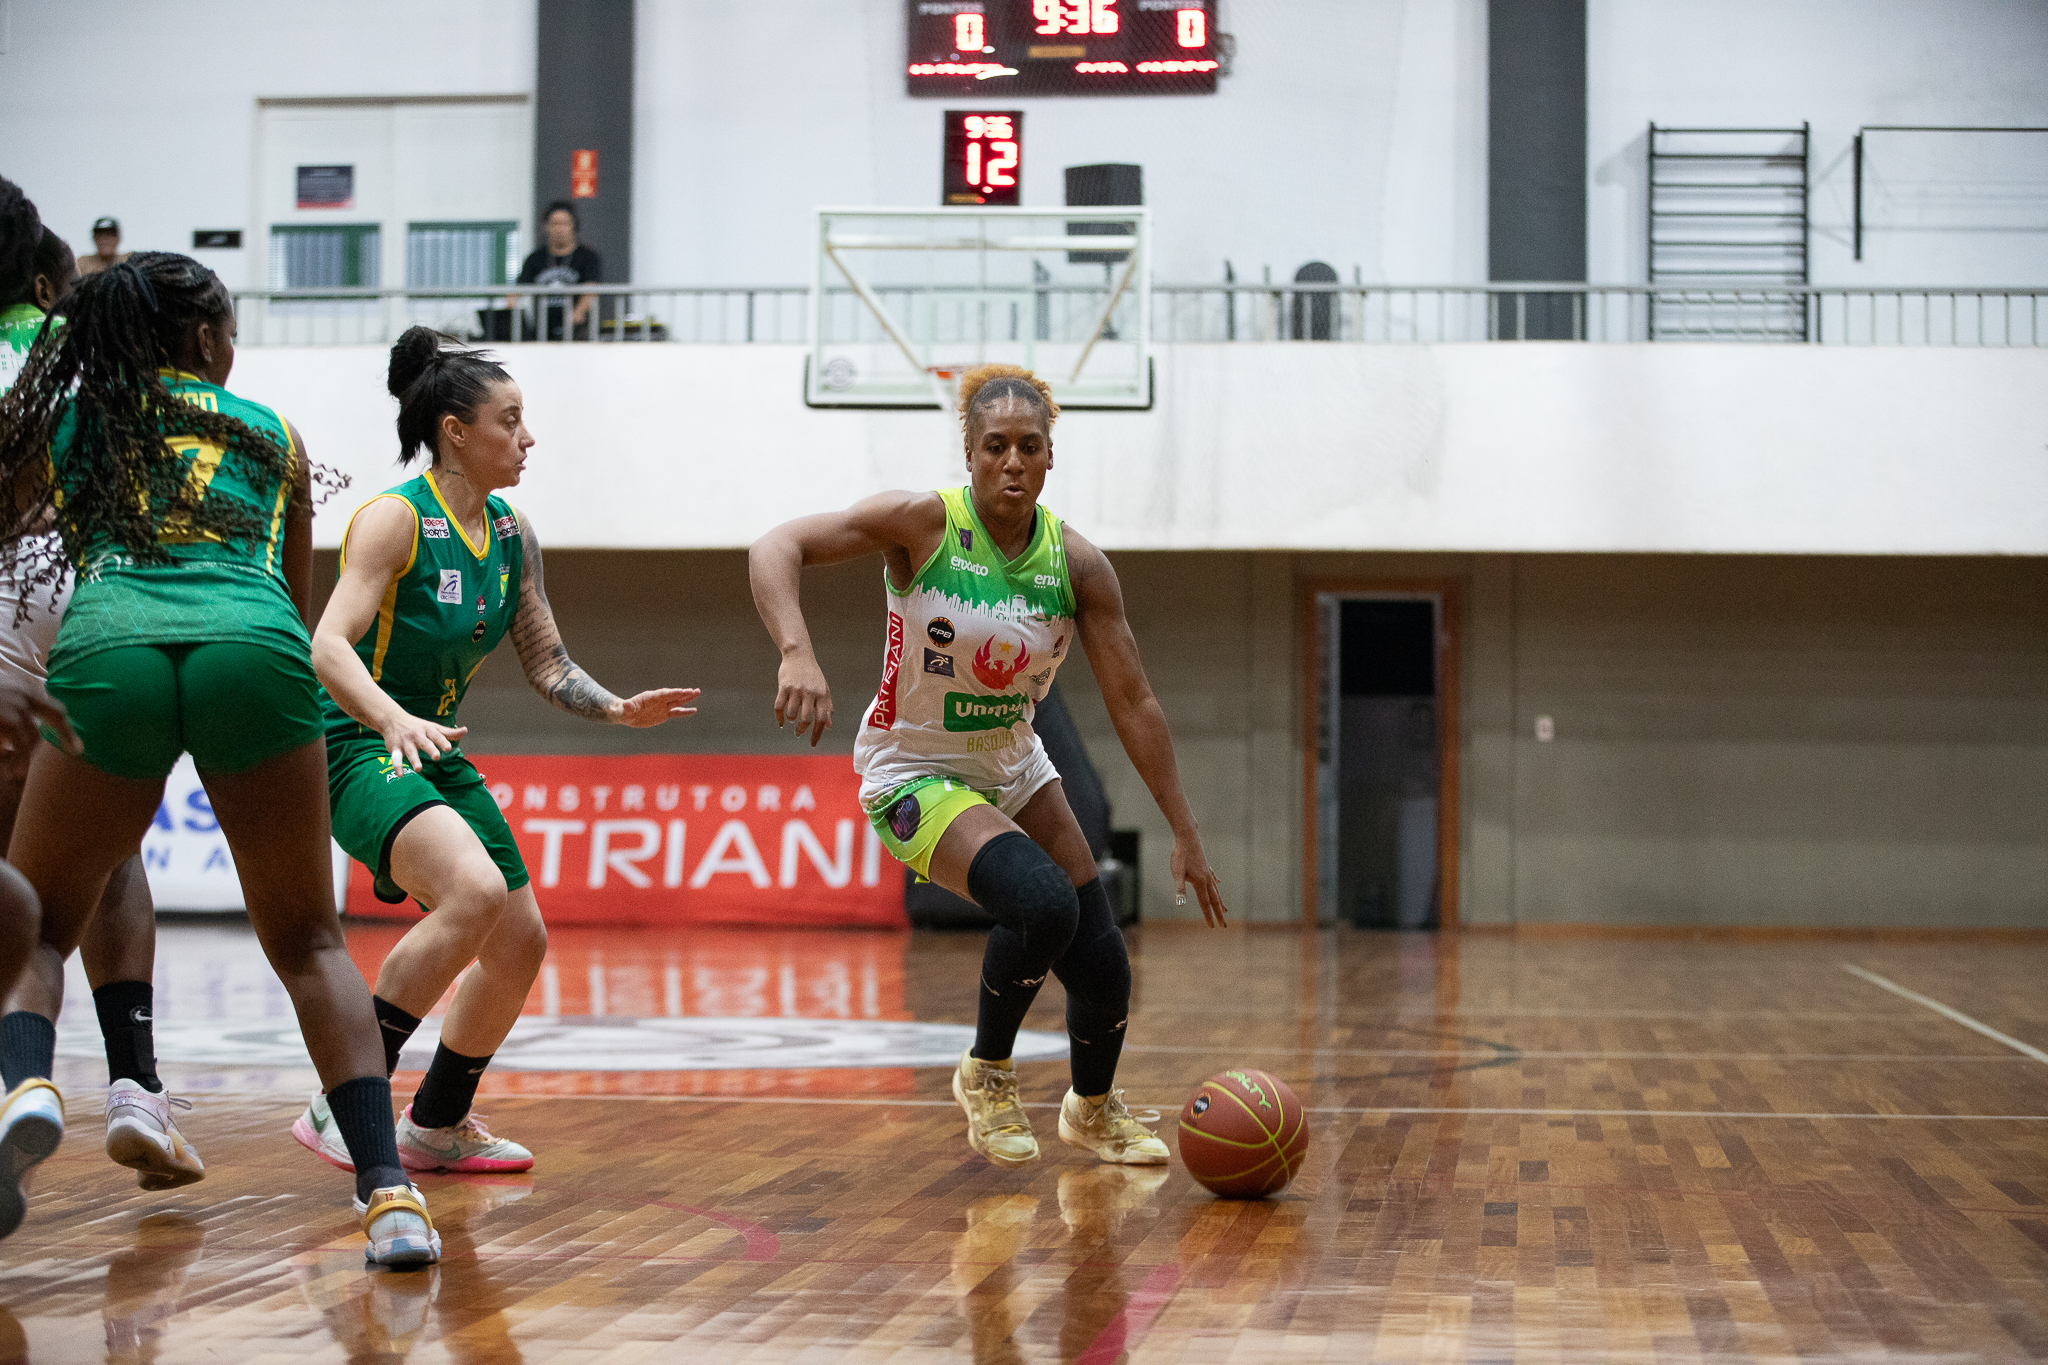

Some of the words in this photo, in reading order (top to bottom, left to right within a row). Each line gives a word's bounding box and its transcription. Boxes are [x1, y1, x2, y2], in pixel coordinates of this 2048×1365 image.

[954, 12, 985, 51] 0
[1177, 9, 1207, 48] 0
[966, 141, 1018, 186] 12
[873, 615, 902, 727] PATRIANI
